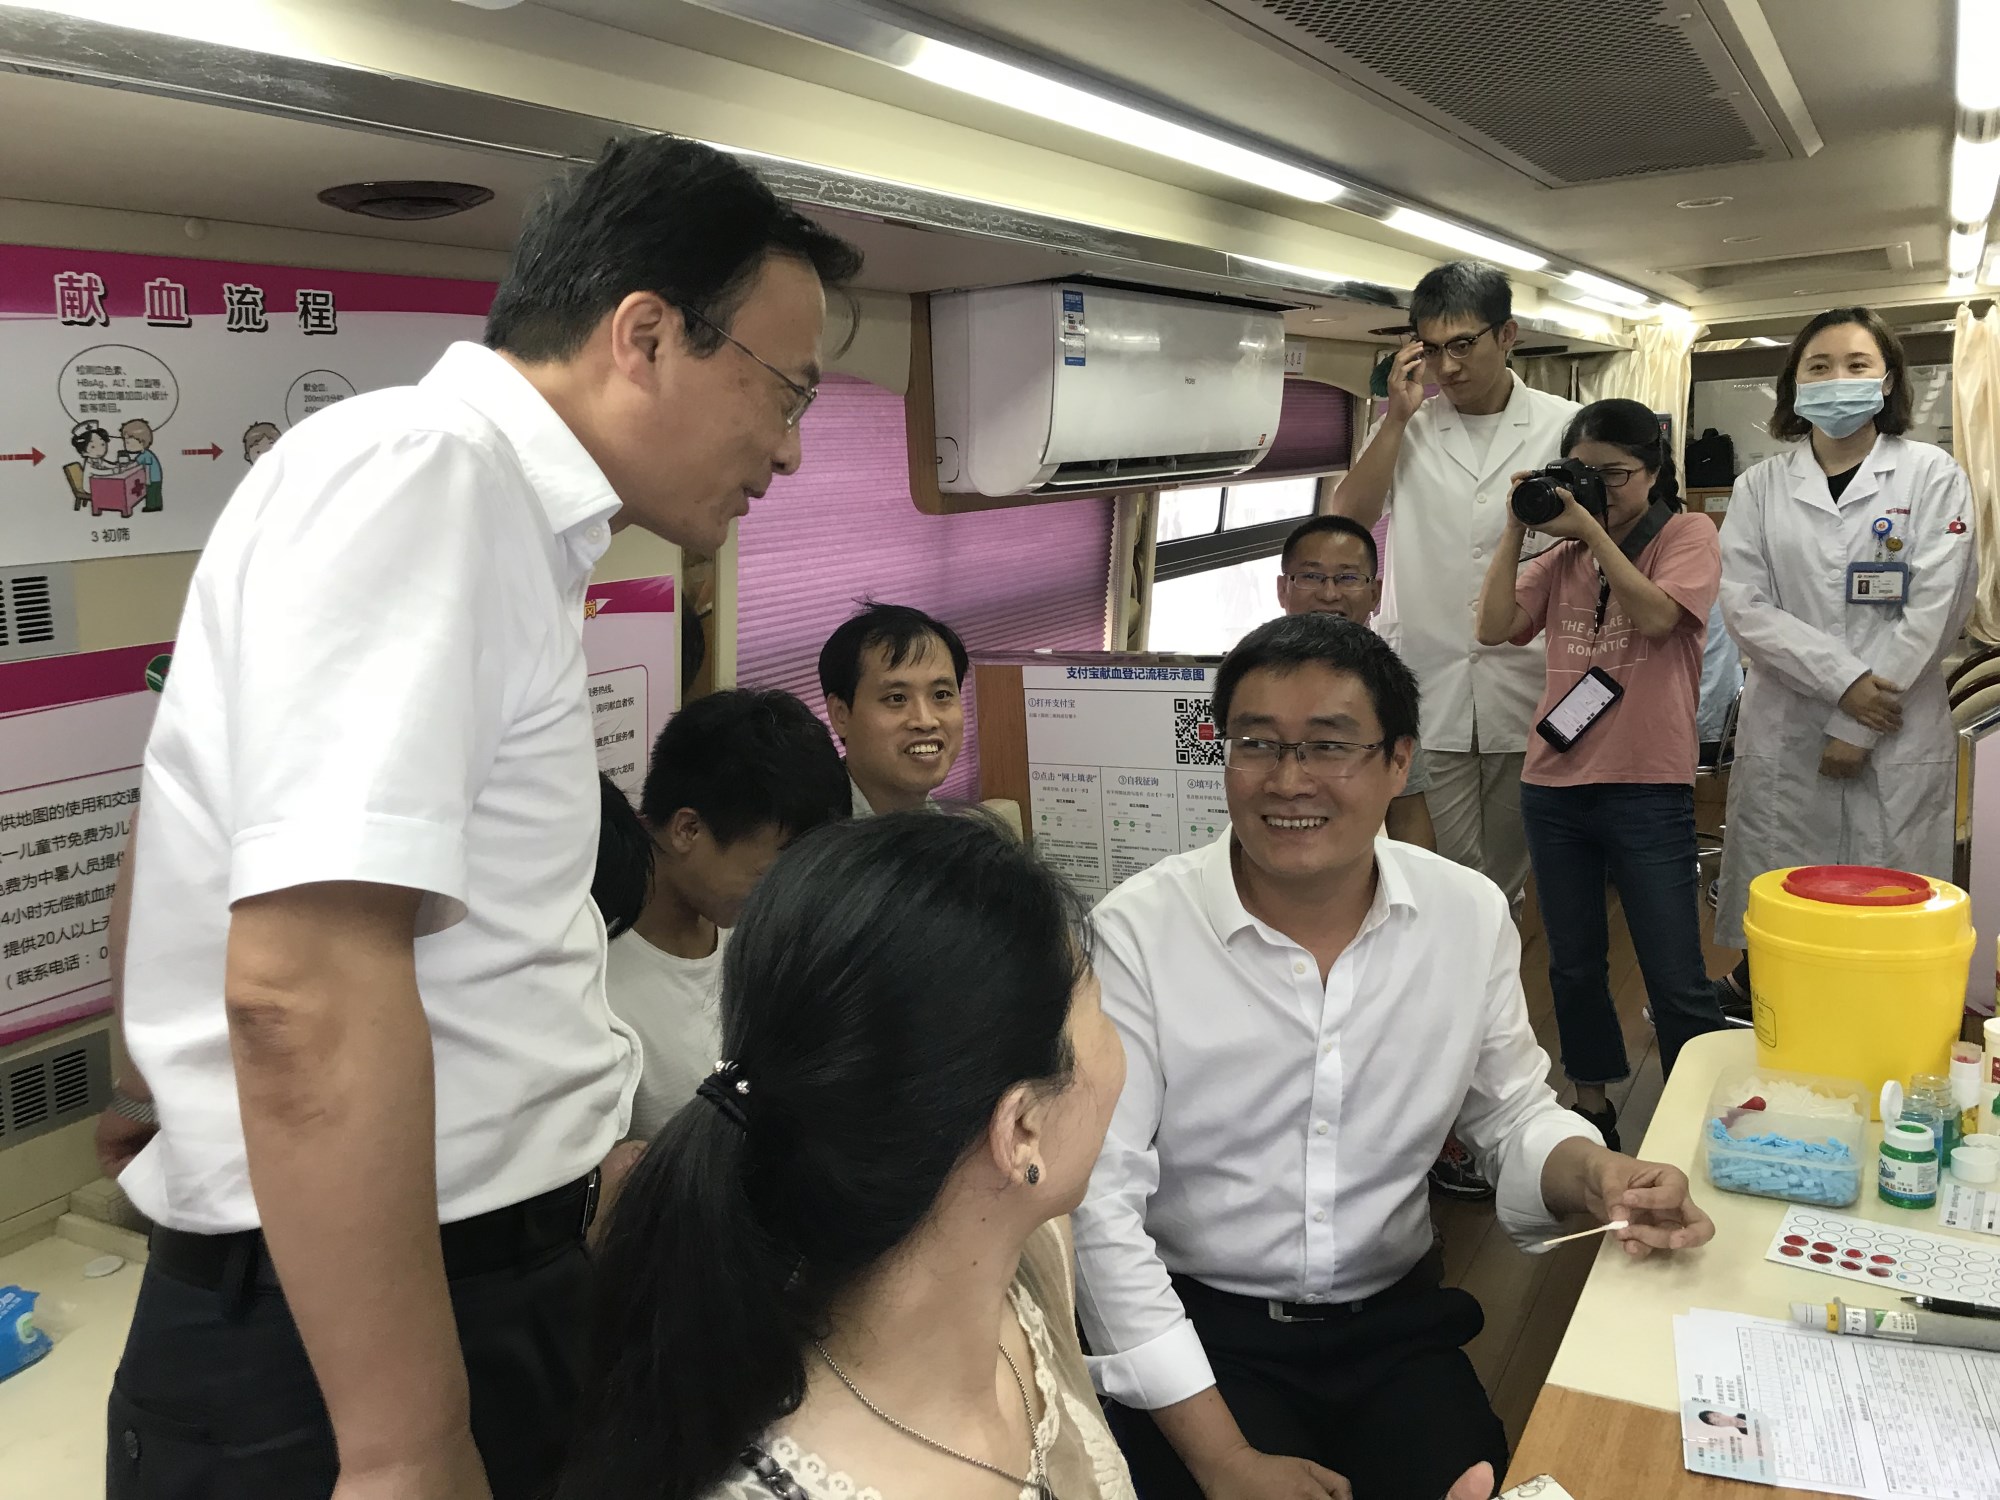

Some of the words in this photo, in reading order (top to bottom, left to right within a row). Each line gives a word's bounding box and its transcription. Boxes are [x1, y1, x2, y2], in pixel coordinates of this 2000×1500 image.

[55, 272, 338, 335] 献血流程
[91, 530, 99, 543] 3
[102, 527, 130, 543] 初筛
[1561, 620, 1586, 634] THE
[1066, 666, 1205, 681] 支付宝献血登记流程示意图
